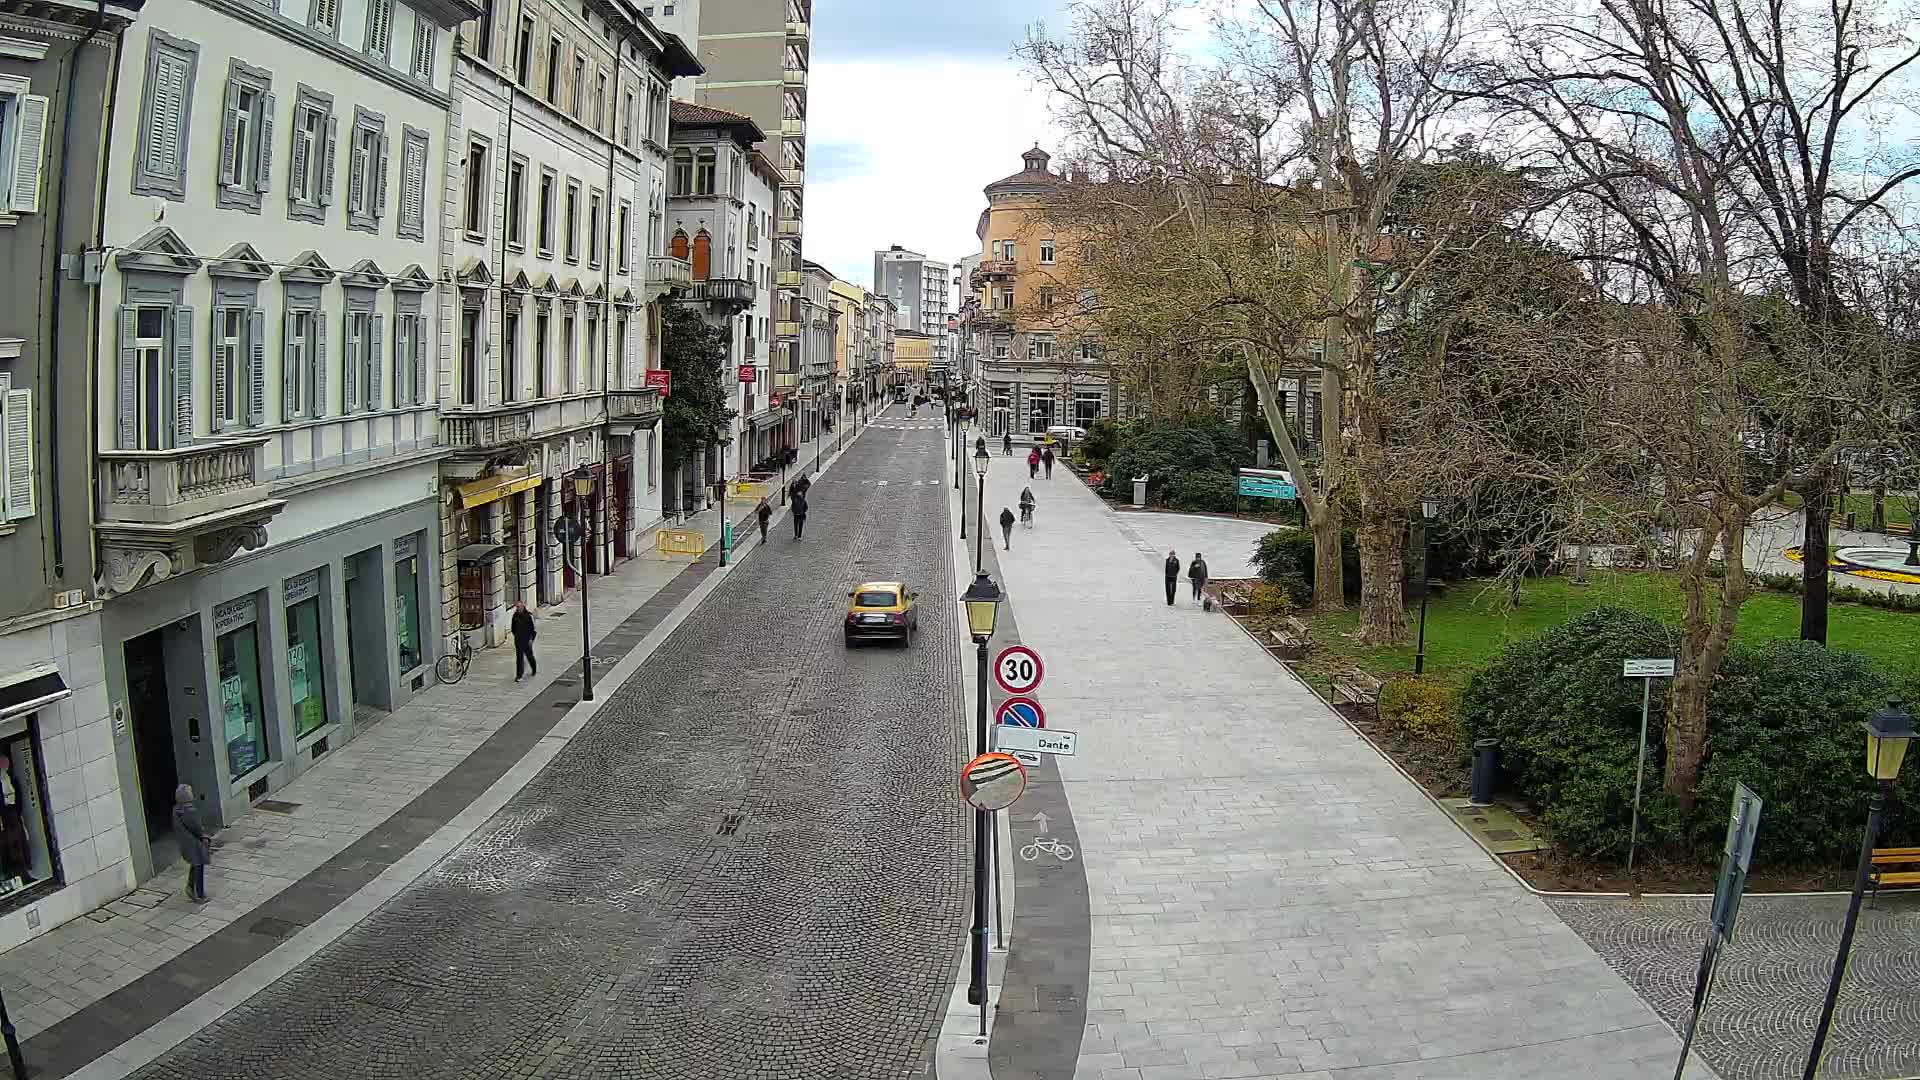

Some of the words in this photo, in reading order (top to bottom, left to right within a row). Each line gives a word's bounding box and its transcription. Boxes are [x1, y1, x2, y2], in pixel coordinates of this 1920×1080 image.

[1005, 659, 1033, 681] 30
[223, 679, 241, 701] 130
[1038, 739, 1070, 751] Dante
